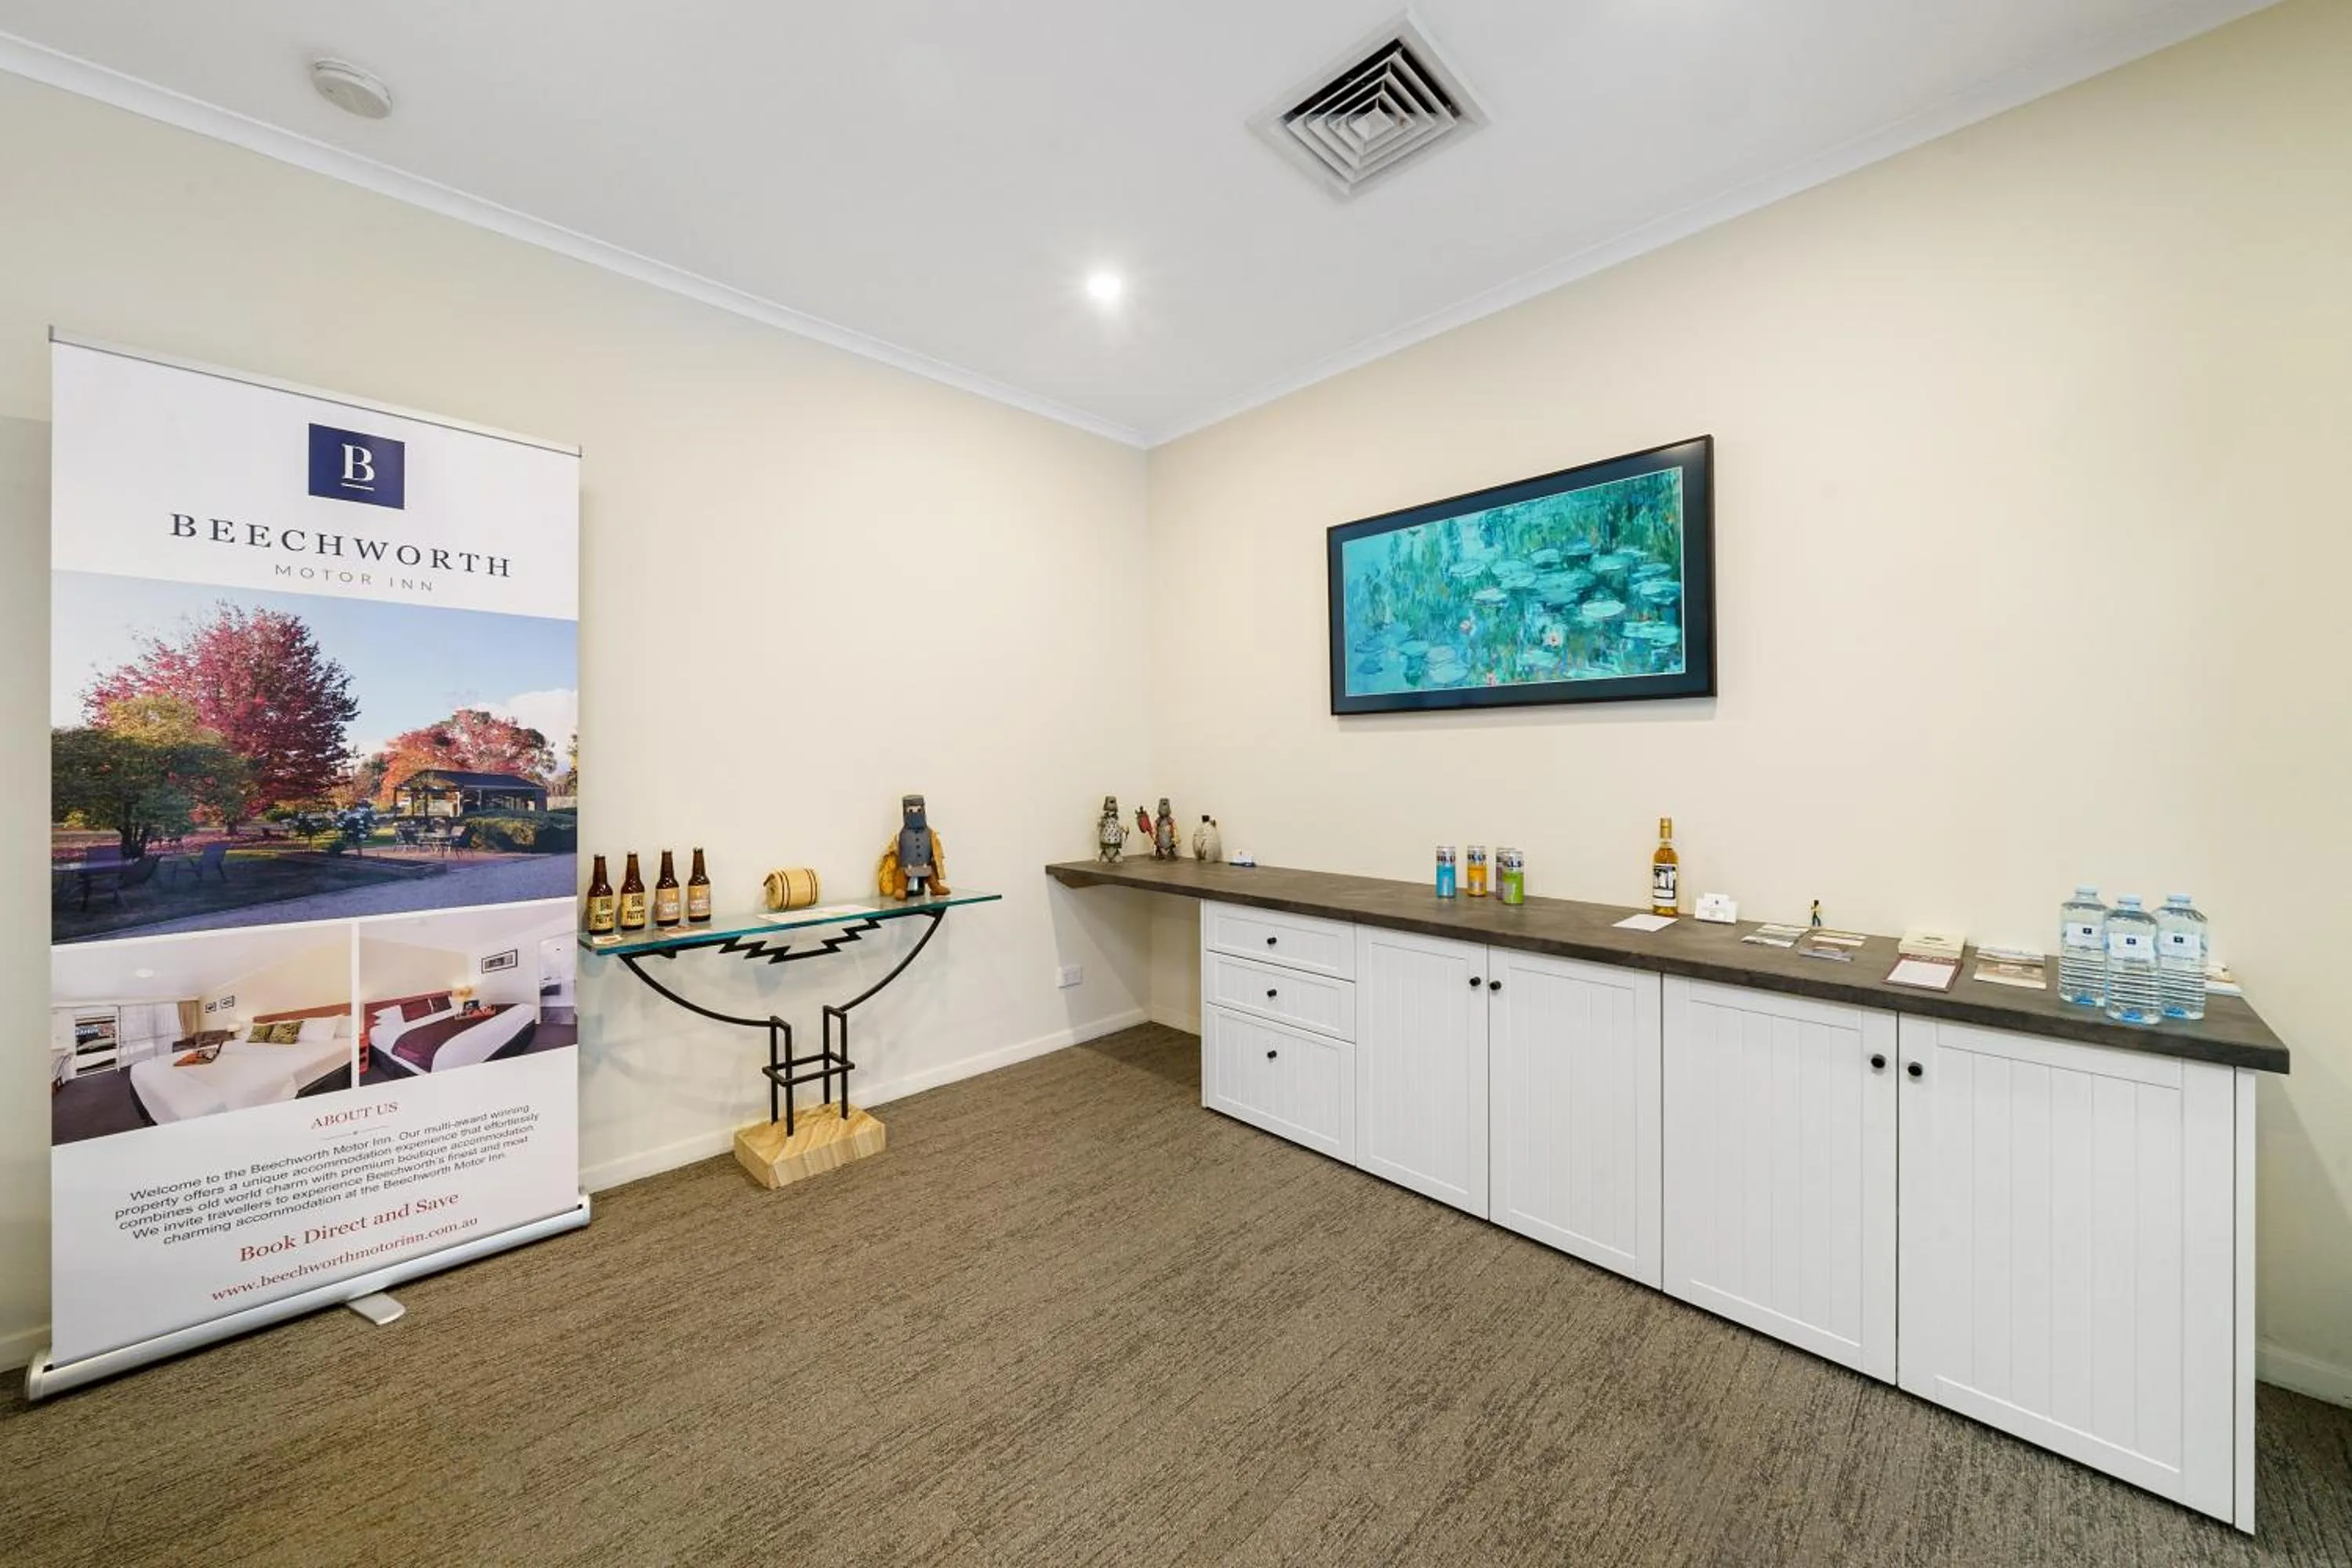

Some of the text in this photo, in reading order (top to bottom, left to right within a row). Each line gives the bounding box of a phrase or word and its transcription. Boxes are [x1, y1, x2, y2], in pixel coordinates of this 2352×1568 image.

[342, 443, 375, 483] B
[170, 513, 511, 578] BEECHWORTH
[274, 563, 434, 592] MOTOR INN
[129, 1179, 201, 1201] Welcome
[206, 1174, 220, 1184] to
[224, 1168, 246, 1180] the
[250, 1148, 330, 1174] Beechworth
[332, 1141, 369, 1156] Motor
[398, 1129, 420, 1141] Our
[424, 1112, 488, 1136] multi-award
[490, 1105, 529, 1120] winning
[310, 1101, 398, 1130] ABOUT US
[114, 1112, 540, 1220] property offers a unique accommodation experience that effortlessly
[118, 1124, 534, 1230] combines old world charm with premium boutique accommodation
[132, 1135, 529, 1240] We invite travellers to experience Beechworth's finest and most
[163, 1221, 232, 1245] charming
[236, 1191, 341, 1226] accommodation
[345, 1187, 358, 1198] at
[361, 1181, 379, 1194] the
[383, 1163, 451, 1189] Beechworth
[454, 1156, 486, 1171] Motor
[212, 1216, 478, 1302] www.beechworthmotorinn.com.au
[238, 1192, 460, 1262] Book Direct and Save
